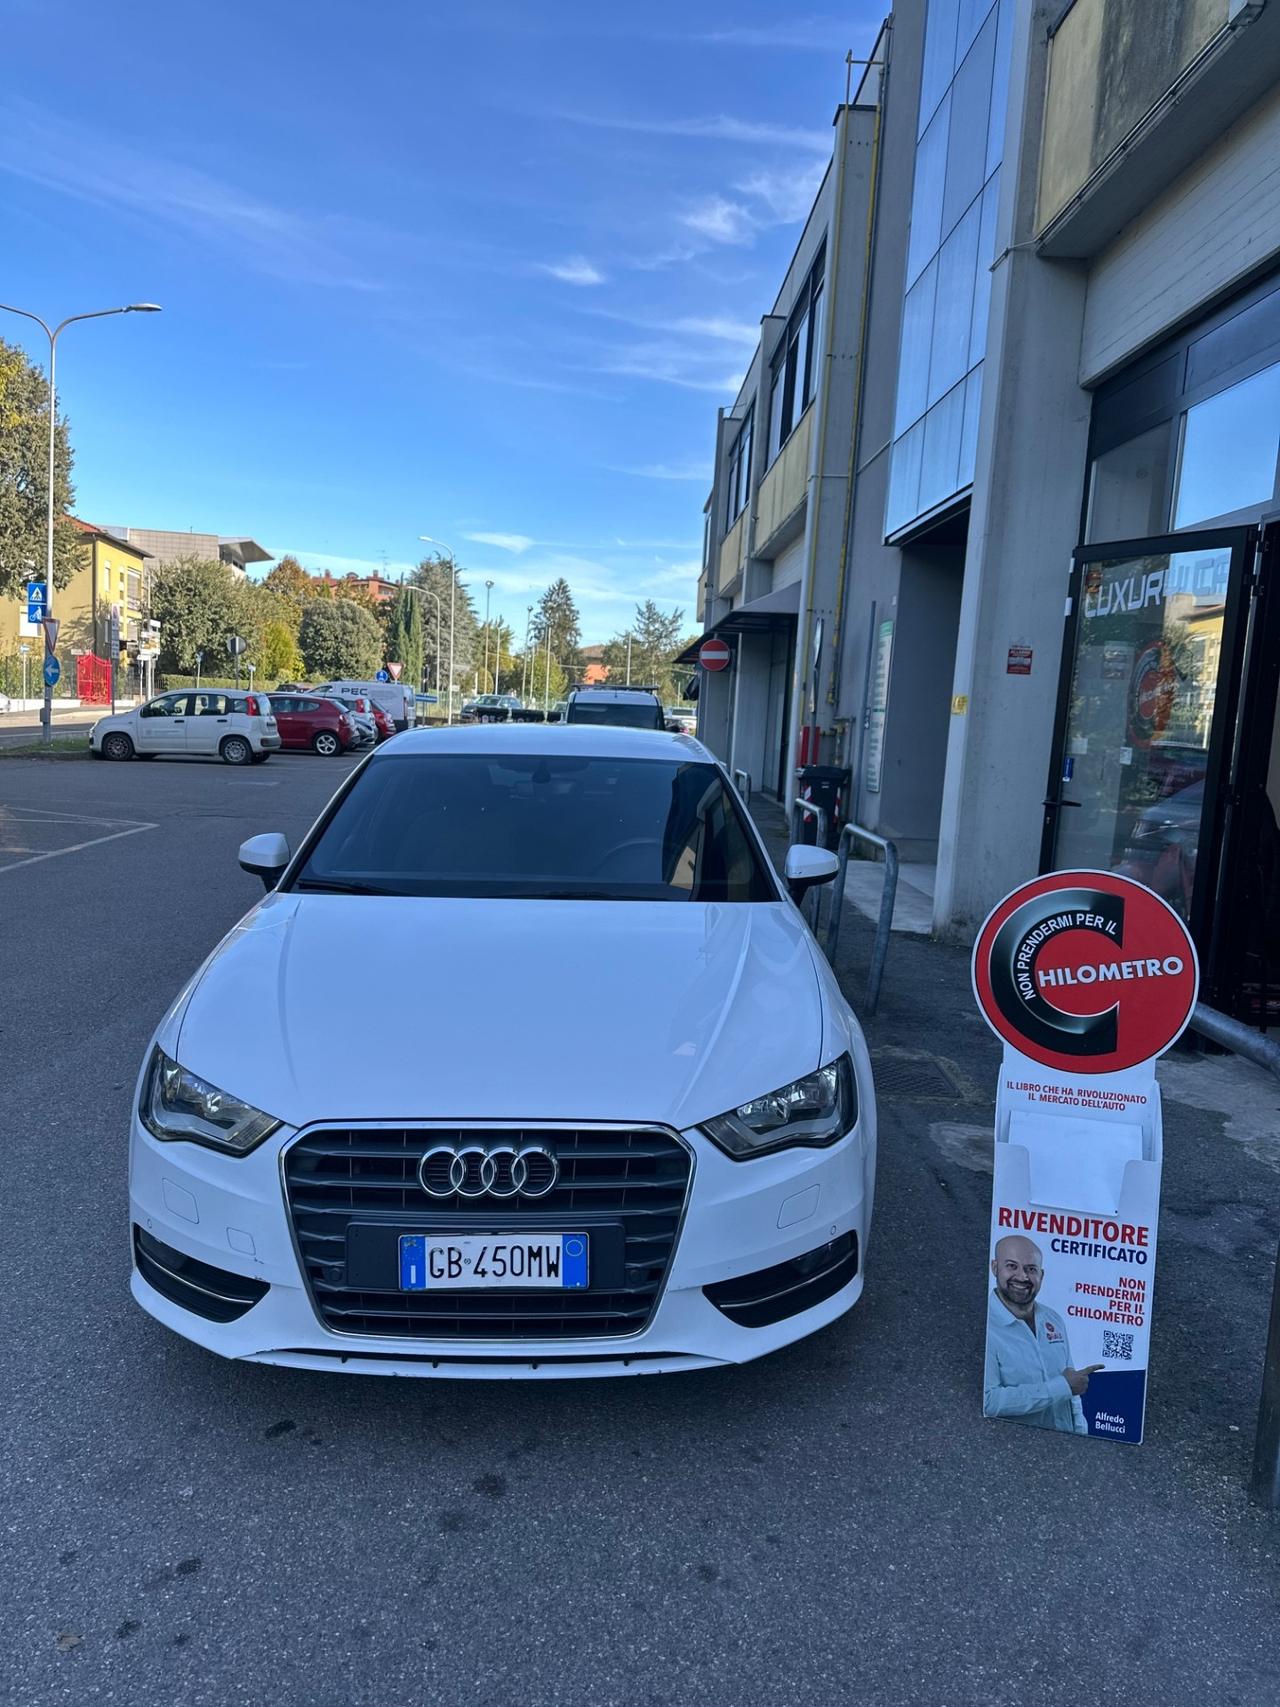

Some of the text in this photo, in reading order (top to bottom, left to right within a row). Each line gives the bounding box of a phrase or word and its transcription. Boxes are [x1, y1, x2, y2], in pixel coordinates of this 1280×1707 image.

[341, 687, 368, 696] PEC
[1017, 913, 1117, 1001] NON PRENDERMI PER IL
[1007, 1081, 1147, 1105] IL LIBRO CHE HA RIVOLUZIONATO
[1028, 1093, 1126, 1111] IL MERCATO DELL'AUTO
[998, 1207, 1149, 1247] RIVENDITORE
[429, 1245, 560, 1279] GB 450MW
[1051, 1238, 1148, 1265] CERTIFICATO
[1075, 1282, 1145, 1303] PRENDERMI
[1119, 1276, 1146, 1291] NON
[1067, 1305, 1144, 1327] CHILOMETRO
[1109, 1300, 1145, 1315] PER IL
[1095, 1411, 1125, 1424] Alfredo
[1095, 1421, 1126, 1435] Bellucci
